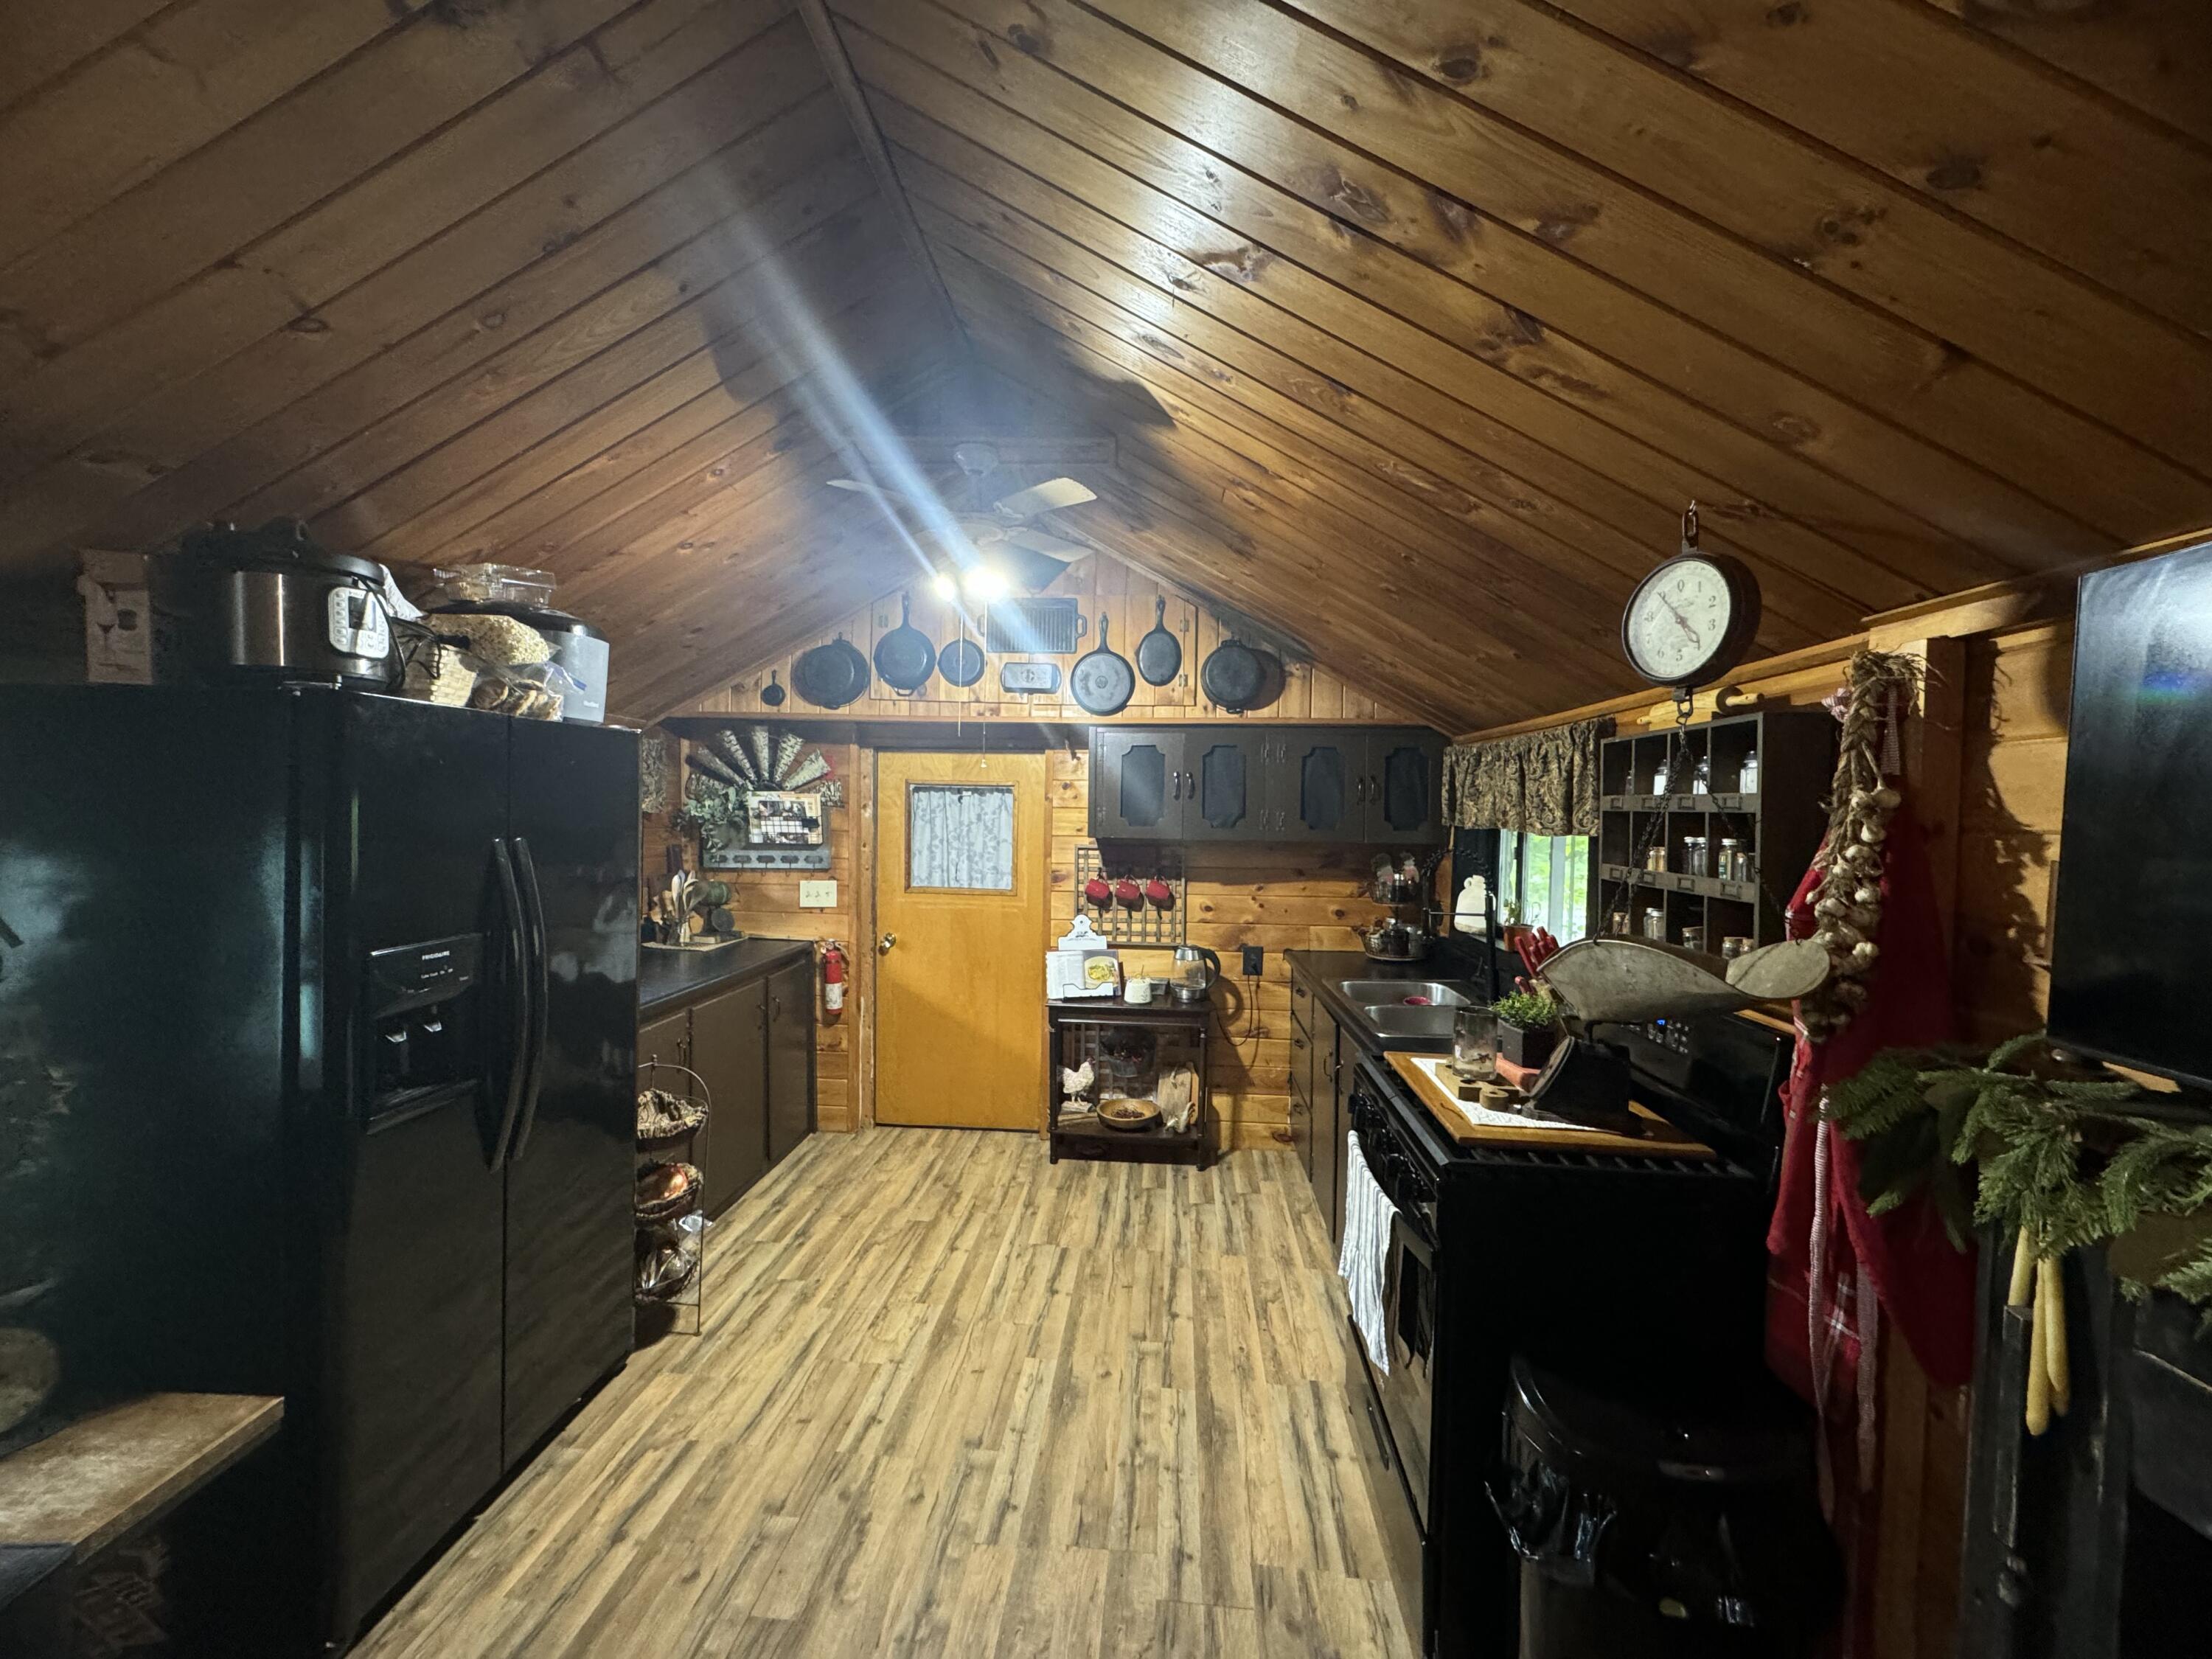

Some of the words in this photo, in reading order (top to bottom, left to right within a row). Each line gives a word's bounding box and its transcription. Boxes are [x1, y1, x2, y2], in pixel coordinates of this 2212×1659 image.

[1677, 580, 1685, 592] 0
[1697, 581, 1702, 592] 1
[1708, 595, 1717, 608] 2
[1708, 619, 1716, 631] 3
[1675, 650, 1683, 661] 5
